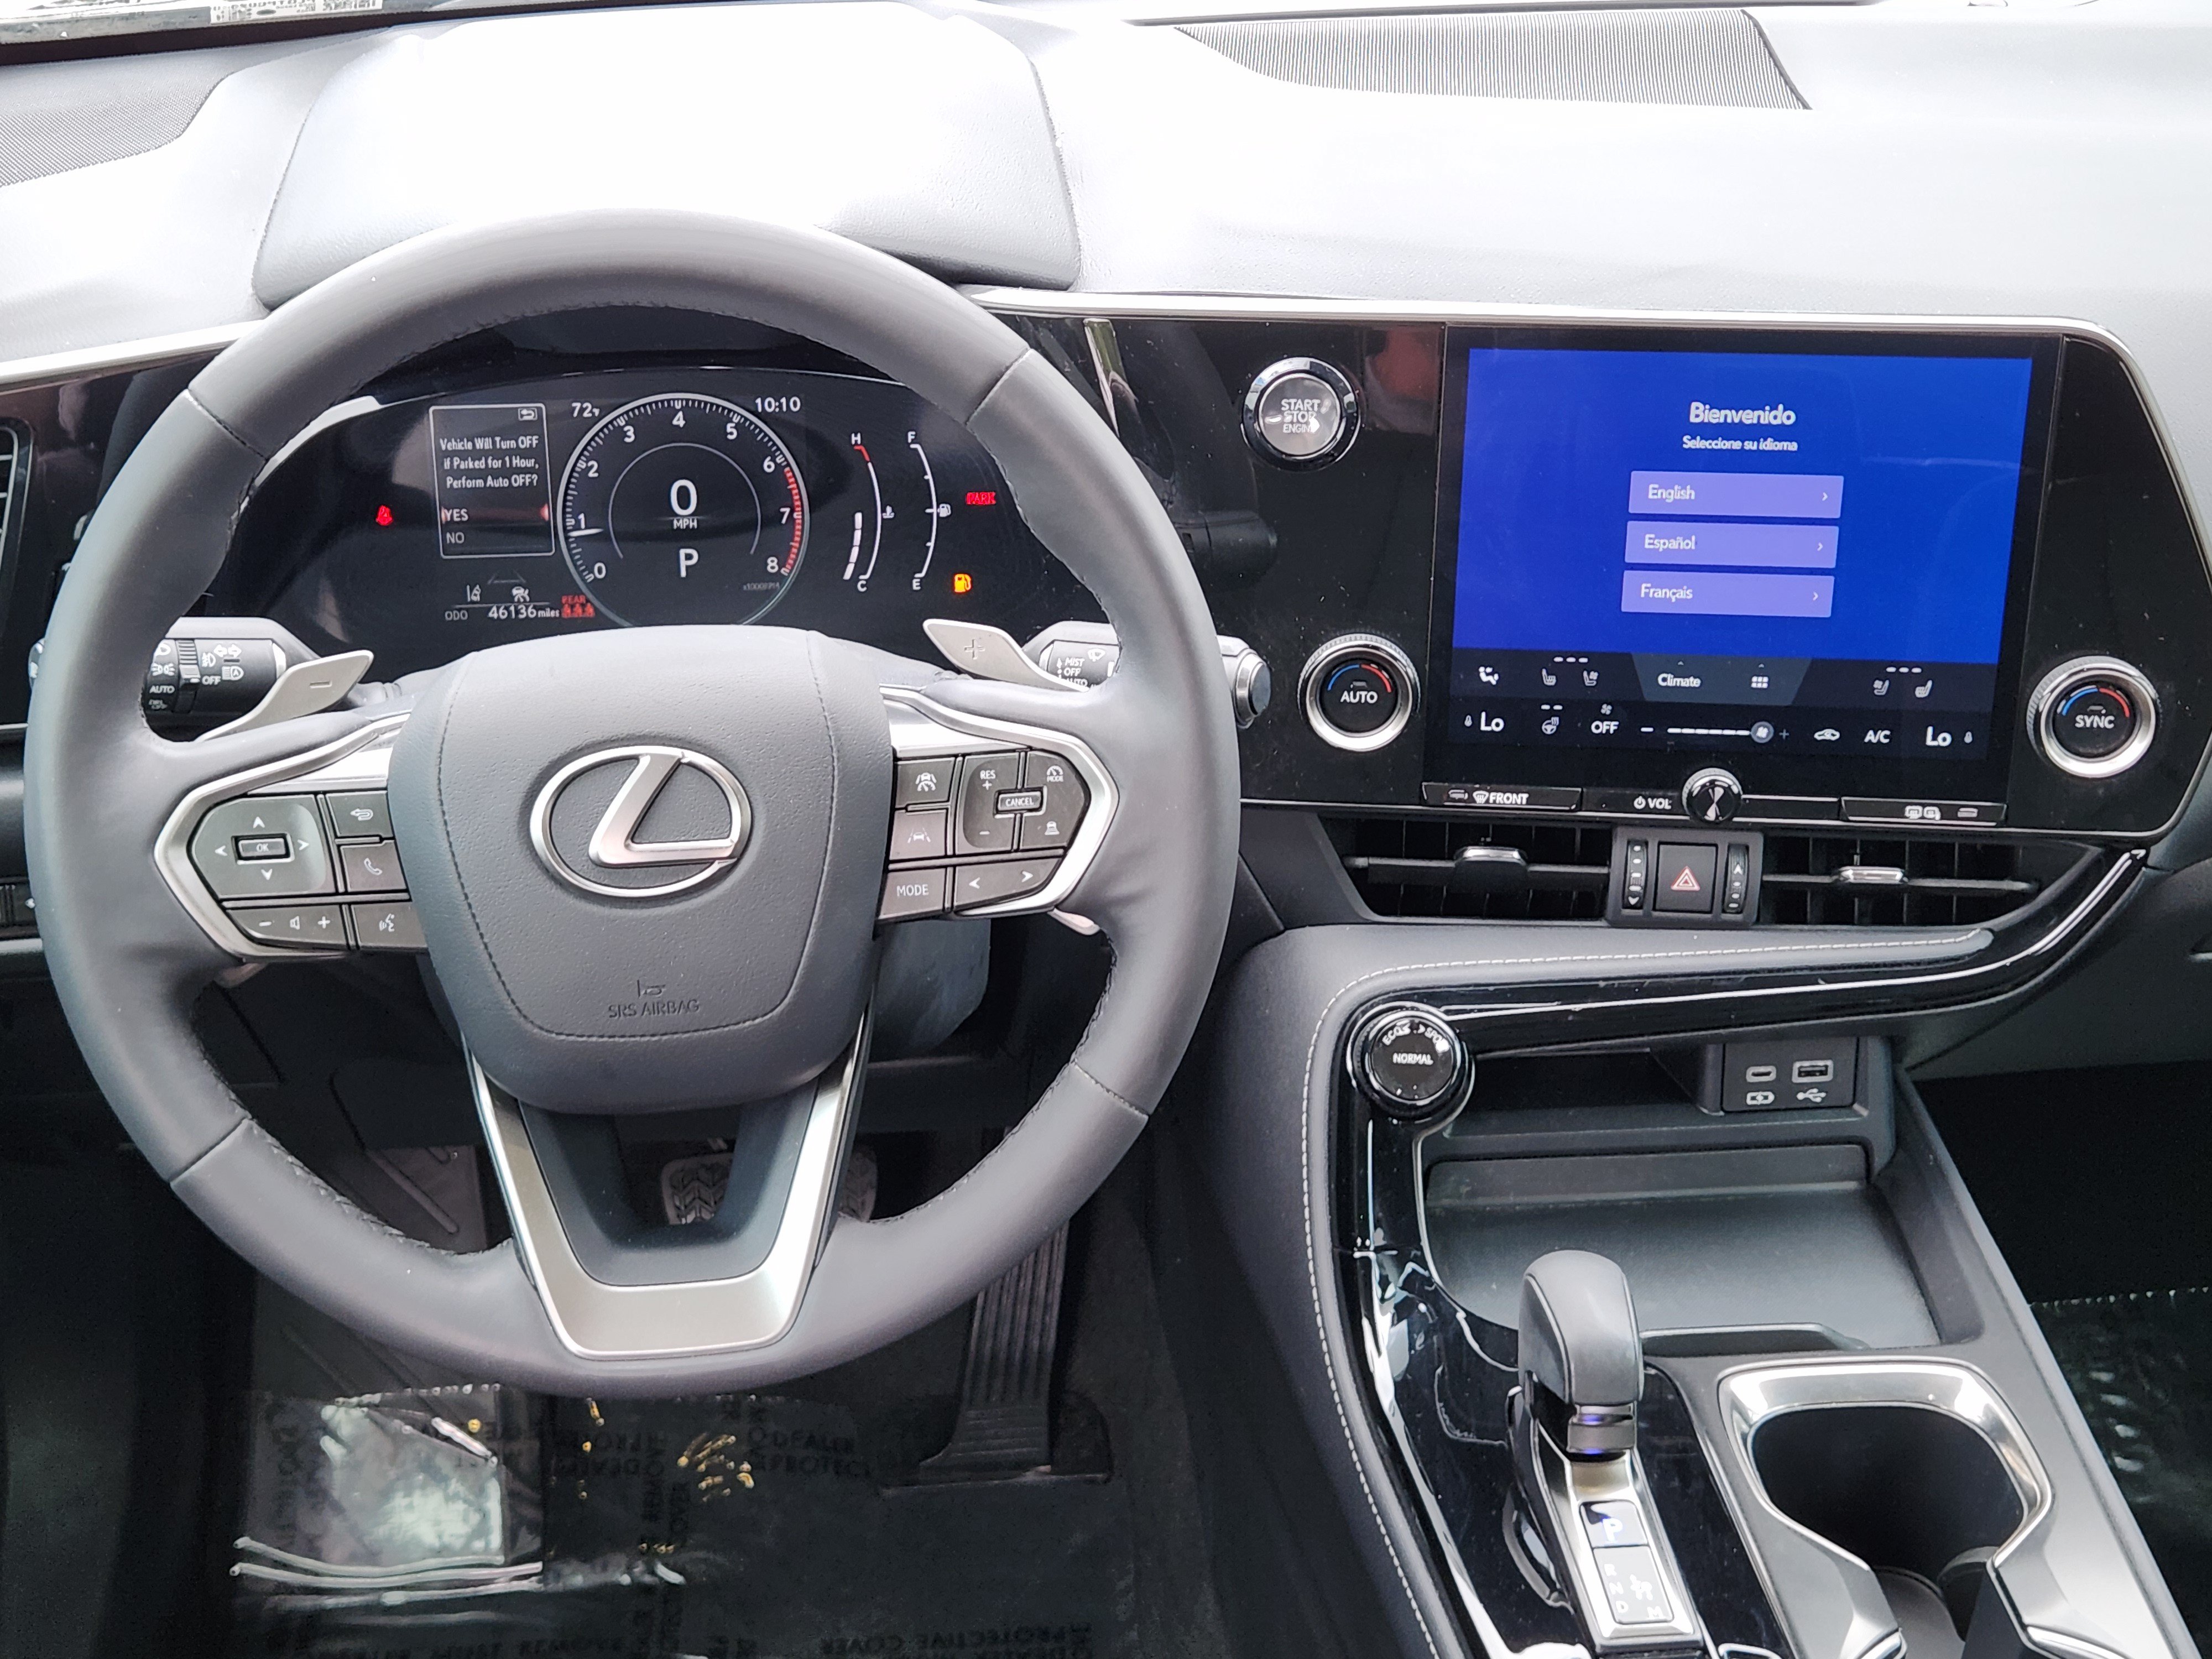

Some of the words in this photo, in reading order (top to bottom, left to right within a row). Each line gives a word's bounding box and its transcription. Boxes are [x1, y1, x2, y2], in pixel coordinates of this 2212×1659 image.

[755, 397, 801, 413] 10:10
[1281, 399, 1321, 411] START
[672, 411, 685, 427] 4
[1689, 401, 1796, 425] Bienvenido
[624, 426, 635, 442] 3
[727, 424, 737, 440] 5
[1282, 424, 1318, 433] ENGIN
[440, 437, 473, 451] Vehicle
[474, 437, 492, 449] Will
[495, 436, 517, 448] Turn
[518, 436, 539, 448] OFF
[851, 432, 861, 445] H
[907, 431, 916, 444] F
[1682, 435, 1742, 450] Seleccione
[1744, 439, 1757, 450] su
[1759, 437, 1798, 452] idioma
[453, 457, 485, 469] Parked
[487, 456, 502, 468] for
[505, 456, 510, 468] 1
[512, 456, 539, 469] Hour,
[587, 461, 599, 477] 2
[763, 456, 775, 473] 6
[446, 476, 484, 489] Perform
[486, 476, 509, 487] Auto
[511, 474, 538, 487] OFF?
[670, 479, 697, 515] 0
[1647, 484, 1695, 503] English
[445, 508, 469, 521] YES
[578, 513, 585, 529] 1
[780, 508, 790, 524] 7
[673, 518, 697, 529] MPH
[446, 533, 465, 544] NO
[1644, 534, 1695, 552] Español
[679, 549, 698, 577] P
[766, 557, 778, 573] 8
[594, 563, 606, 578] 0
[857, 581, 867, 592] C
[912, 578, 921, 590] E
[1641, 583, 1693, 602] Français
[445, 611, 468, 621] ODO
[488, 604, 537, 619] 46136
[538, 609, 560, 618] miles
[1065, 657, 1085, 667] MIST
[1063, 667, 1081, 677] OFF
[202, 675, 221, 685] OFF
[1658, 674, 1701, 687] Climate
[149, 685, 175, 694] AUTO
[1340, 691, 1378, 703] AUTO
[1480, 711, 1505, 732] Lo
[1591, 721, 1619, 734] OFF
[2075, 714, 2115, 728] SYNC
[1864, 729, 1891, 744] A/C
[1926, 726, 1952, 747] Lo
[980, 770, 996, 780] RES
[1005, 797, 1034, 806] CANCEL
[1489, 793, 1529, 805] FRONT
[1648, 797, 1672, 809] VOL
[256, 843, 269, 853] OK
[896, 884, 929, 897] MODE
[609, 1003, 637, 1018] SRS
[641, 999, 700, 1016] AIRBAG
[1392, 1052, 1433, 1065] NORMAL
[1602, 1518, 1623, 1542] P
[1604, 1564, 1616, 1577] R
[1609, 1582, 1624, 1595] N
[1615, 1600, 1629, 1613] D
[1647, 1606, 1663, 1619] M
